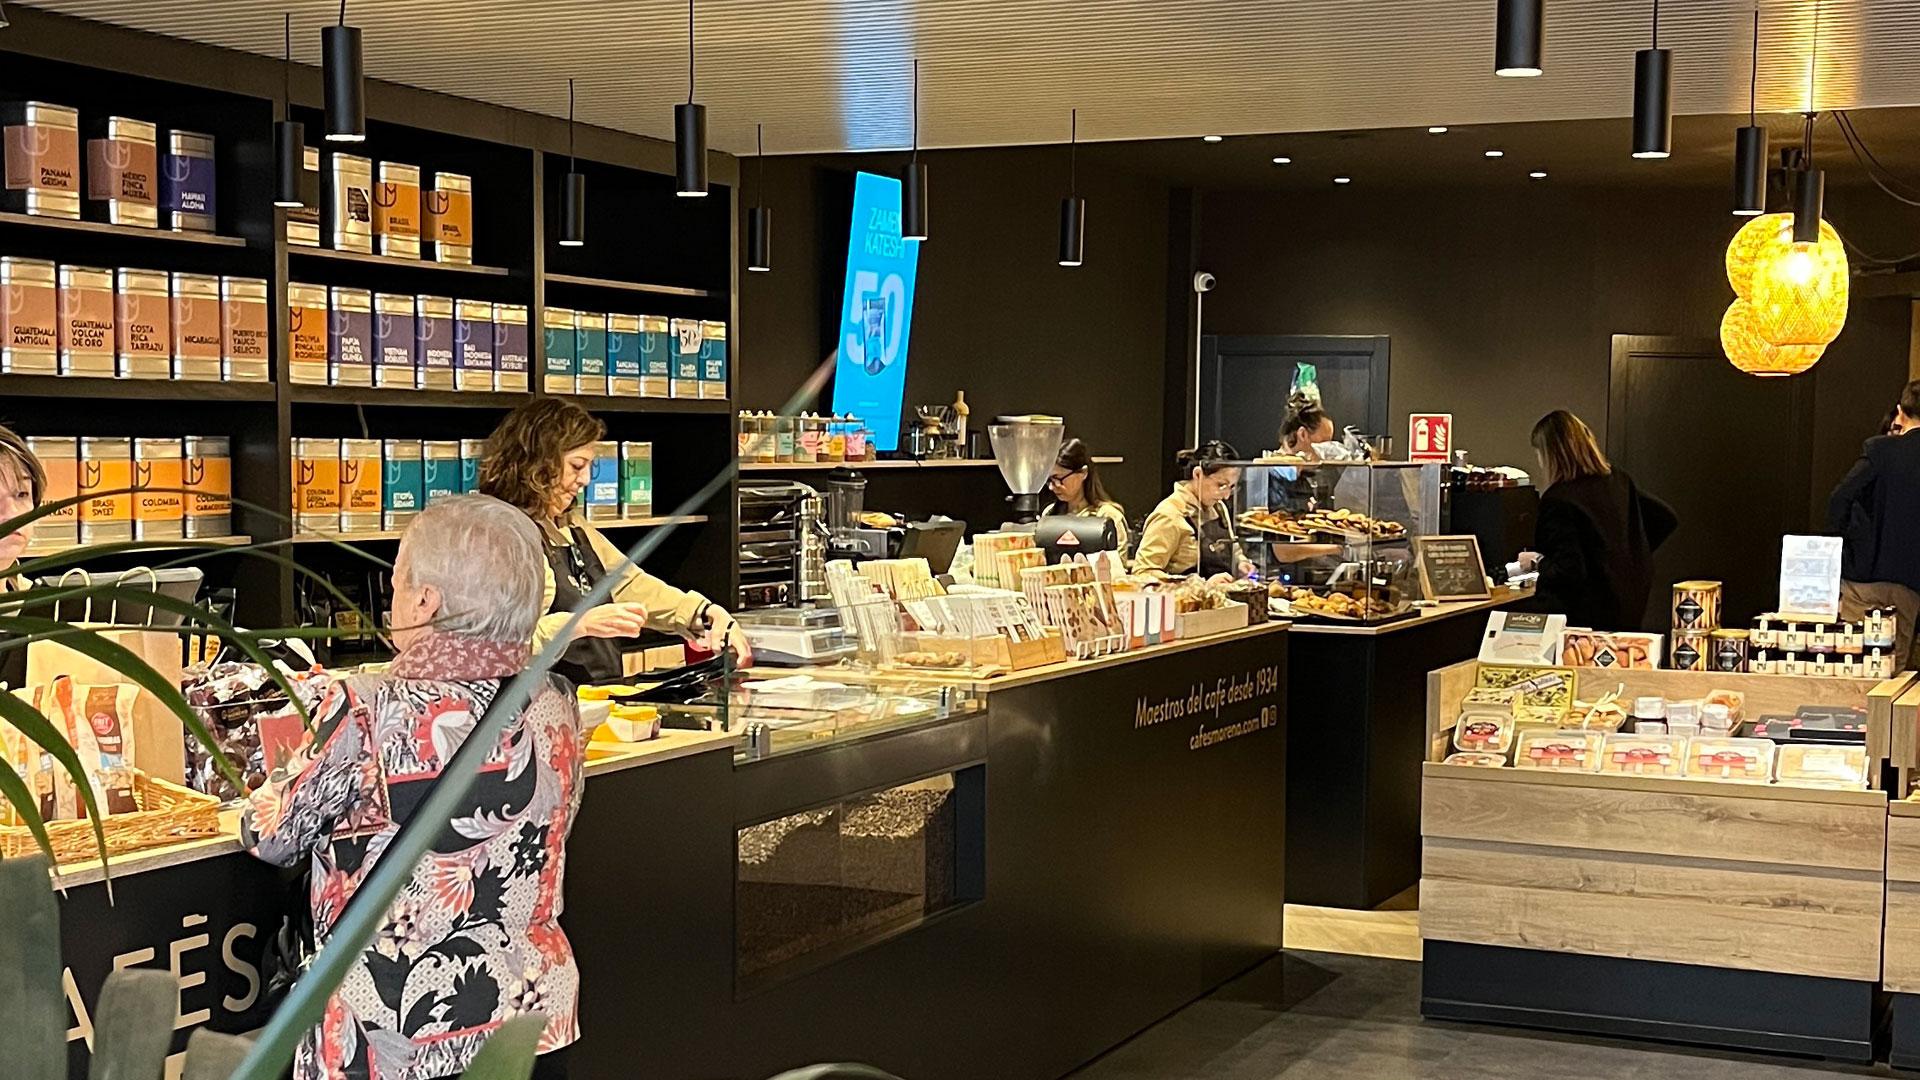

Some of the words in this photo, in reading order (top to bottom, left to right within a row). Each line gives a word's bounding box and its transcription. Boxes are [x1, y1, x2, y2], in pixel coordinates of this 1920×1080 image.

[122, 180, 144, 191] FINCA
[182, 200, 205, 210] ALOHA
[868, 207, 902, 233] ZAMB
[71, 320, 113, 330] GUATEMALA
[131, 324, 154, 333] COSTA
[13, 326, 56, 337] GUATEMALA
[72, 329, 105, 338] VOLCAN
[14, 336, 51, 346] ANTIGUA
[72, 338, 84, 347] DE
[85, 338, 103, 347] ORO
[131, 333, 149, 342] RICA
[142, 498, 180, 507] COLOMBIA
[1134, 696, 1185, 729] Maestros
[1187, 683, 1204, 714] del
[1204, 678, 1226, 719] café
[1227, 671, 1254, 704] desde
[1256, 664, 1279, 697] 1934
[1190, 717, 1260, 750] cafesmoreno.com
[62, 914, 260, 1054] AÉS
